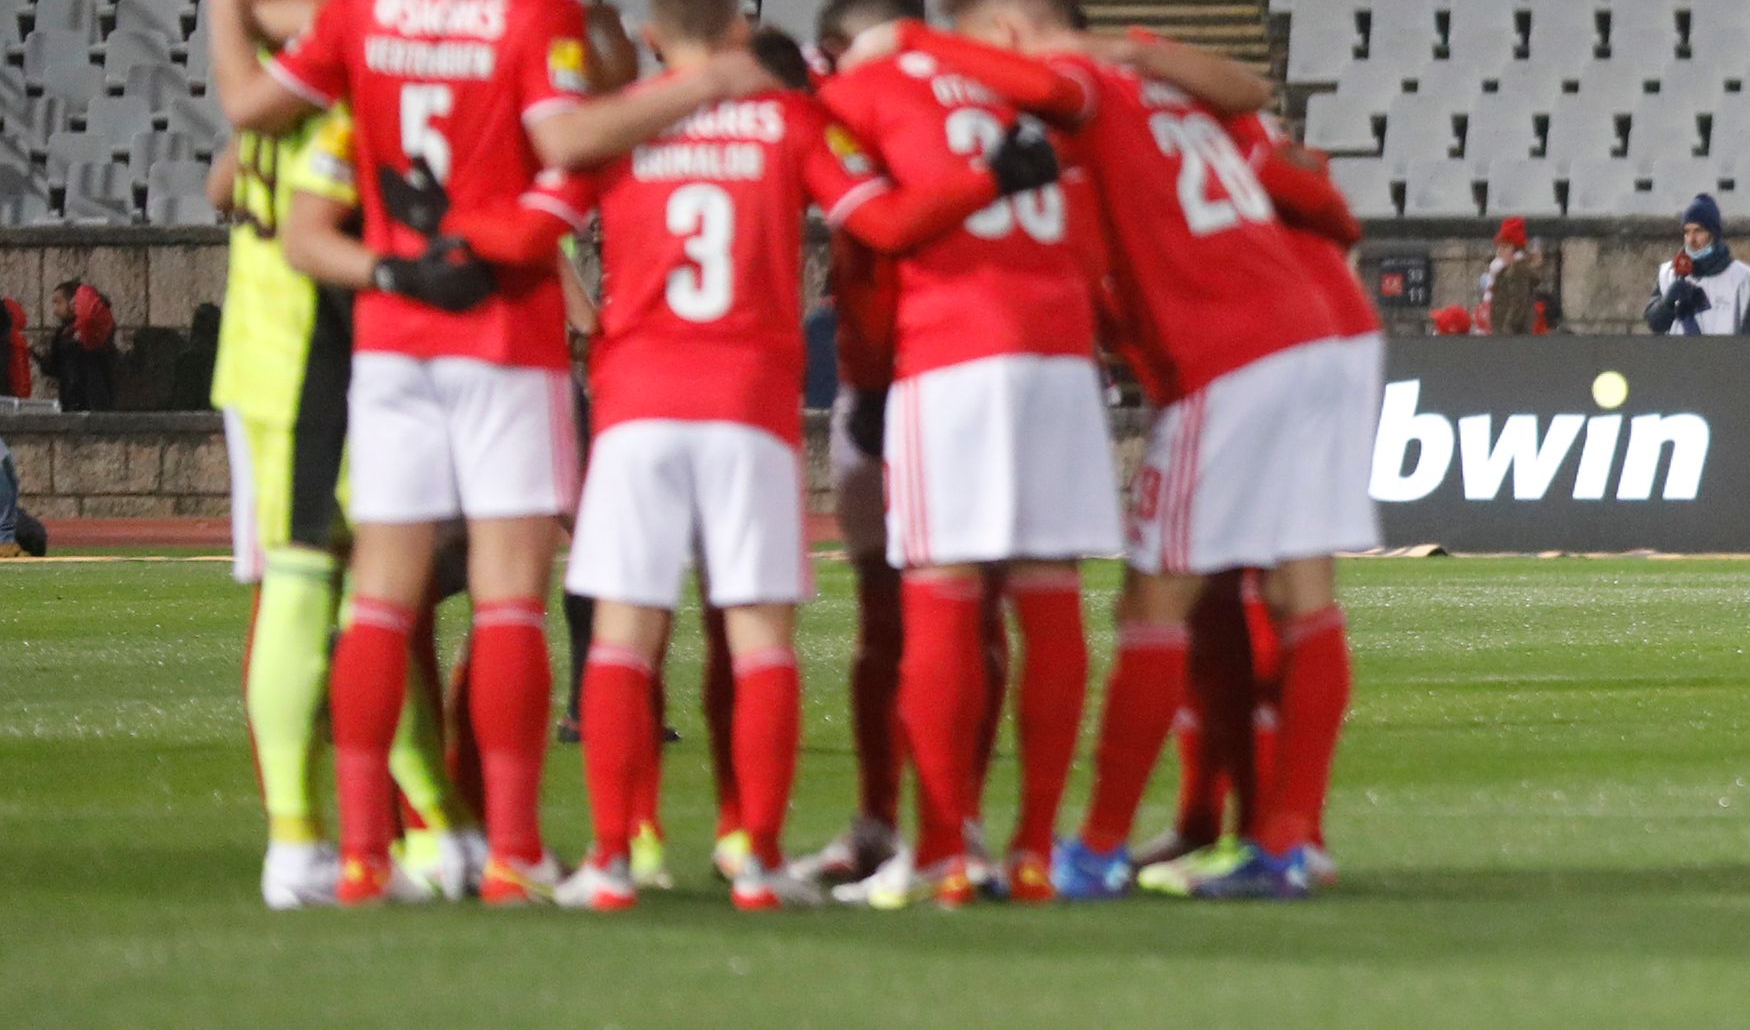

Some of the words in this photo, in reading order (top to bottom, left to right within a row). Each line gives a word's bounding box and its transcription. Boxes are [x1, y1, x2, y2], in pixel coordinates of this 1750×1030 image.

[400, 83, 453, 187] 5
[666, 182, 735, 323] 3
[1368, 370, 1710, 502] bwin
